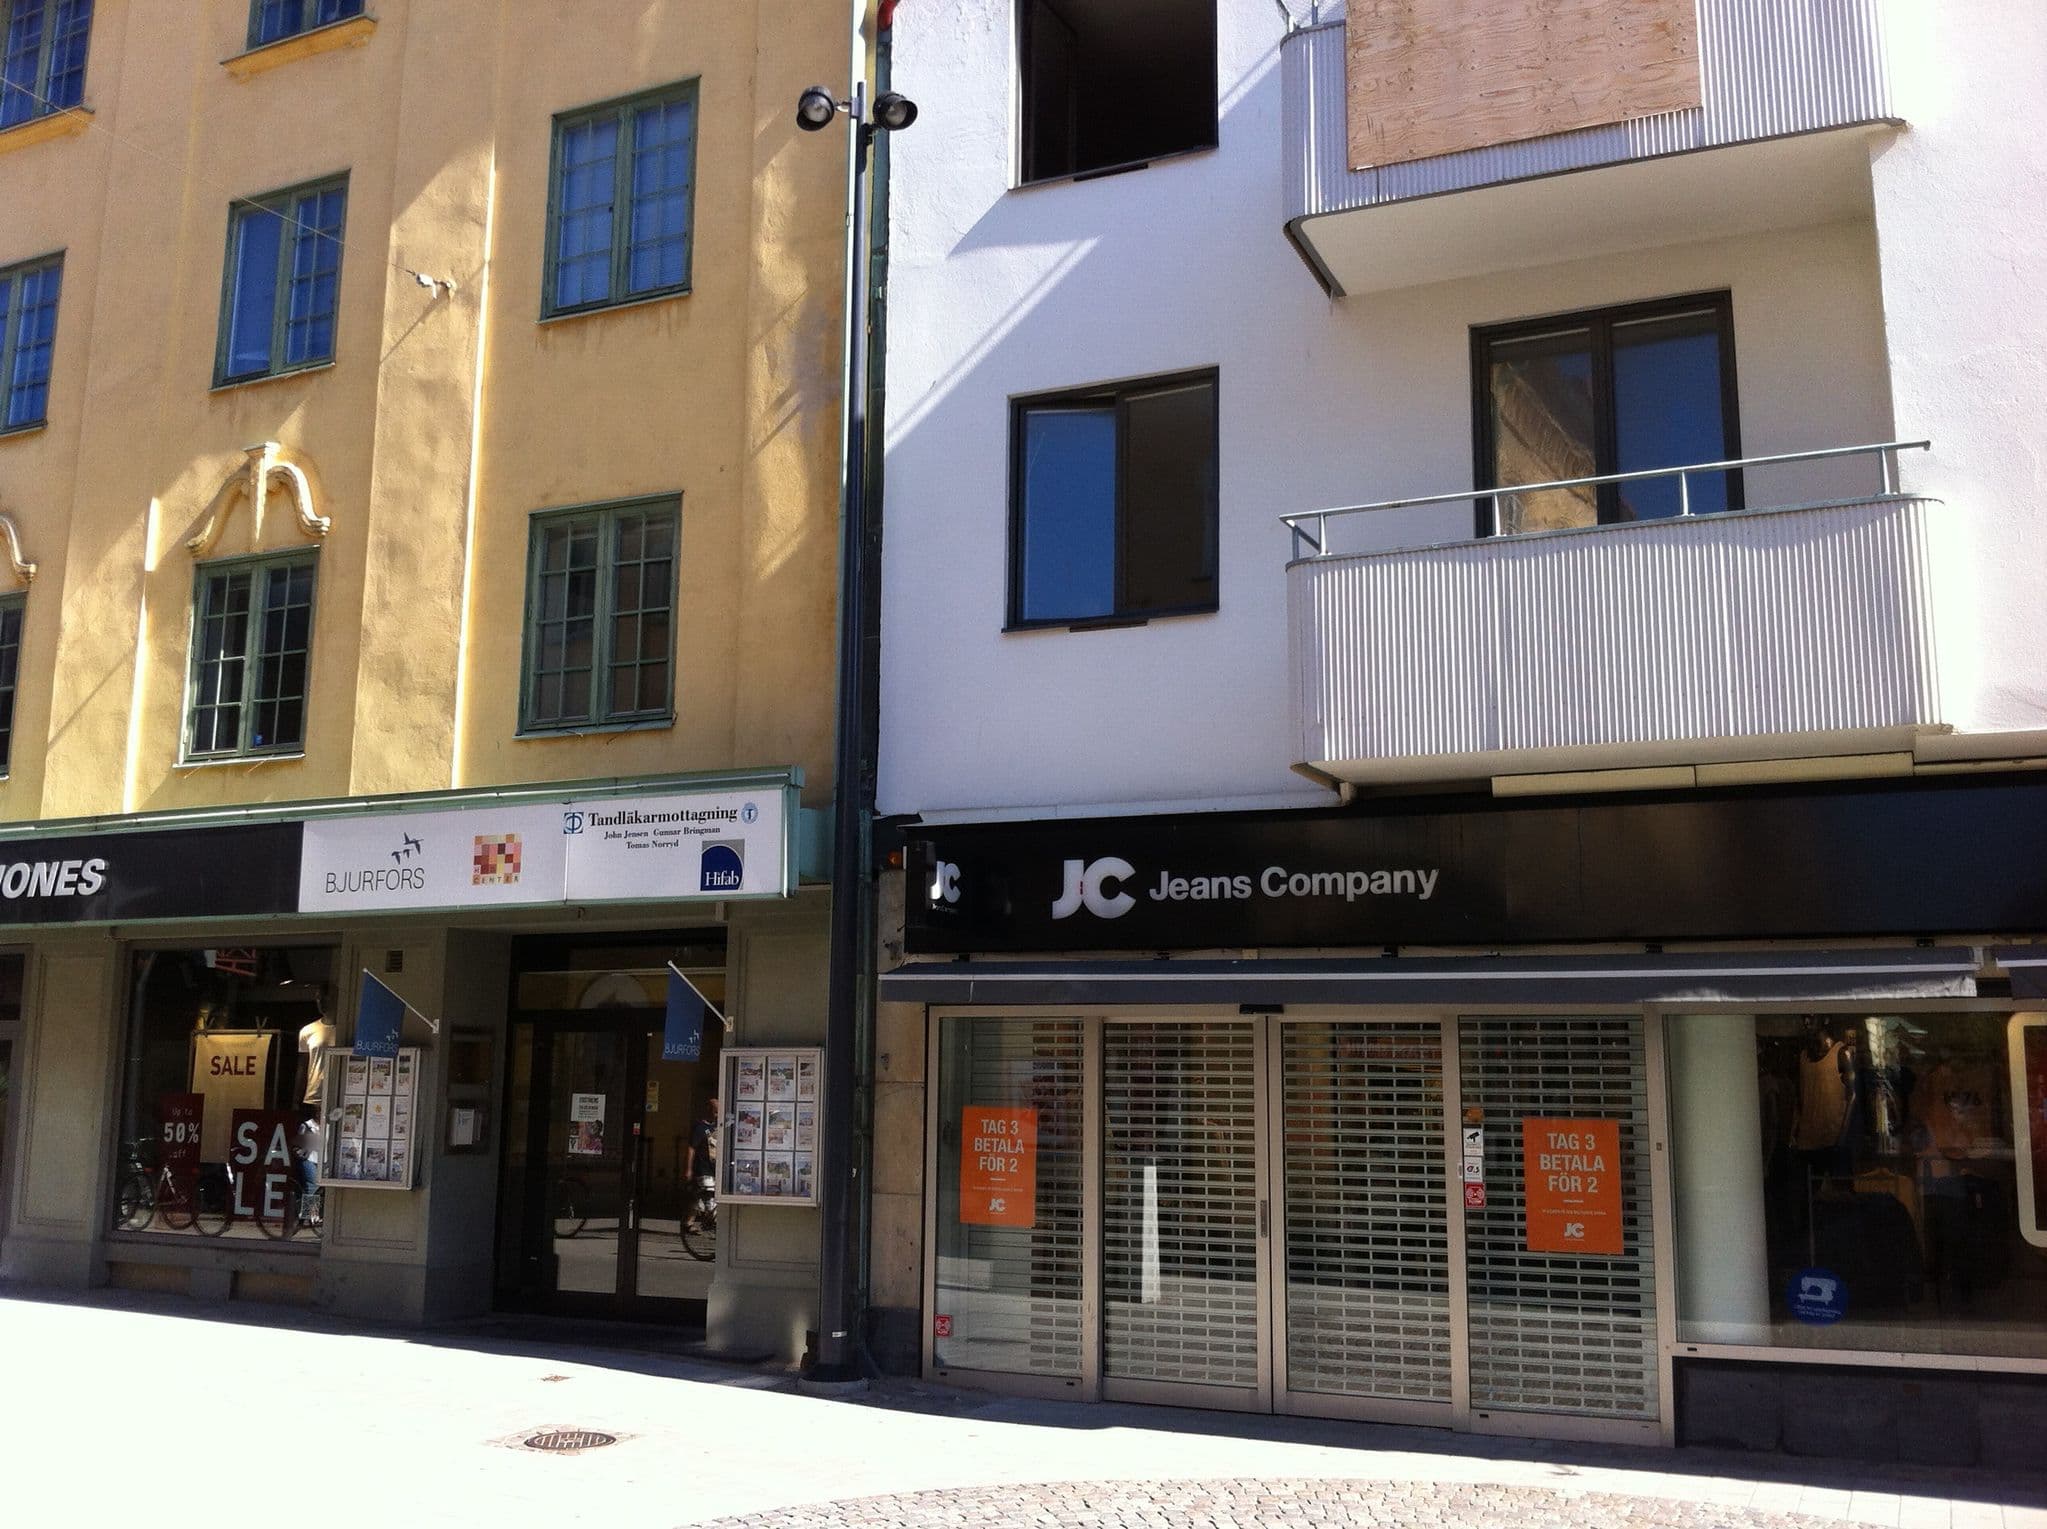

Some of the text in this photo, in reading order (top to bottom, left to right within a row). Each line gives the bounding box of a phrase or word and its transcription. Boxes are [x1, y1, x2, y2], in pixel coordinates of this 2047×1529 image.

[588, 806, 738, 826] Tandläkarmottagning
[604, 830, 622, 840] John
[653, 828, 681, 837] Gunnar
[683, 826, 721, 836] Bringman
[626, 841, 650, 849] Tomas
[325, 867, 425, 893] BJURFORS
[705, 870, 740, 887] Hifab
[930, 860, 961, 903] JC
[1052, 856, 1439, 919] JC Jeans Company
[210, 1055, 257, 1076] SALE
[163, 1121, 200, 1144] 50%
[981, 1119, 1019, 1135] TAG 3
[974, 1137, 1025, 1154] BETALA
[1547, 1132, 1596, 1151] TAG 3
[979, 1154, 1018, 1172] FÖR 2
[1539, 1153, 1606, 1172] BETALA
[1548, 1172, 1599, 1194] FÖR 2
